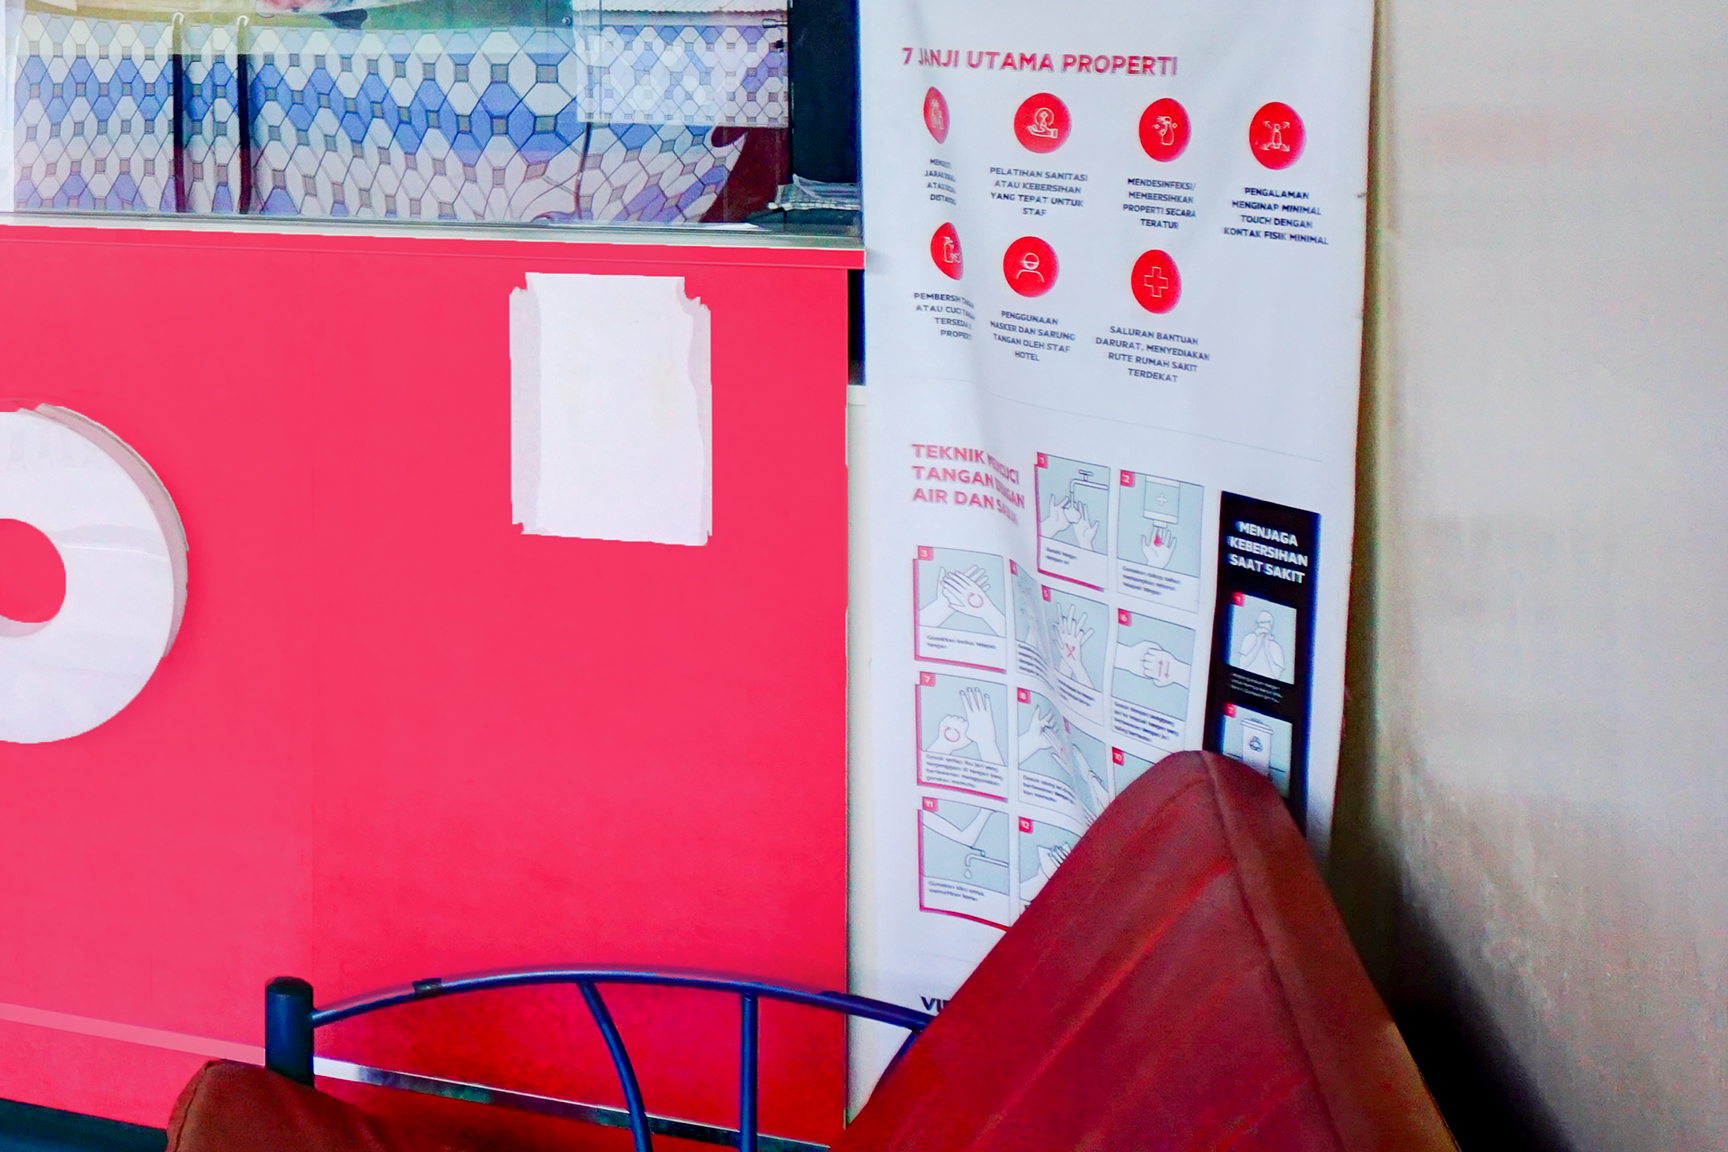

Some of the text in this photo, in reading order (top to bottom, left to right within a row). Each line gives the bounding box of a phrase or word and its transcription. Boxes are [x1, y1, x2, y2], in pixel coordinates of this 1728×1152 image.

[903, 47, 913, 65] 7
[967, 51, 1054, 72] UTAMA
[1062, 54, 1177, 77] PROPERTI
[990, 167, 1088, 182] PELATIHAN SANITASI
[1022, 182, 1081, 194] KEBERSIHAN
[1244, 187, 1309, 199] PENGALAMAN
[991, 193, 1084, 207] YANG TEPAT UNTUK
[1129, 191, 1194, 204] MEMBERSIHKAN
[1023, 208, 1046, 216] STAF
[1123, 204, 1196, 217] PROPERTI SECARA
[1232, 201, 1321, 215] MENGINAP MINIMAL
[1141, 219, 1179, 229] TERATUR
[1241, 215, 1312, 228] TOUCH DENGAN
[1223, 227, 1329, 245] KONTAK FISIK MINIMAL
[916, 305, 943, 313] ATAU
[1001, 311, 1058, 325] PENGGUNAAN
[990, 321, 1075, 341] MASKER DAN SARUNG
[1110, 326, 1198, 345] SALURAN BANTUAN
[993, 333, 1071, 353] TANGAN OLEH STAF
[1014, 350, 1040, 361] HOTEL
[1146, 344, 1210, 360] MENYEDIAKAN
[1108, 352, 1198, 372] RUTE RUMAH SAKIT
[1128, 368, 1178, 382] TERDEKAT
[912, 444, 985, 464] TEKNIK
[912, 466, 994, 489] TANGAN
[912, 488, 994, 510] AIR DAN
[1237, 520, 1298, 547] MENJAGA
[1229, 535, 1308, 567] KEBERSIHAN
[1229, 553, 1305, 583] SAAT SAKIT
